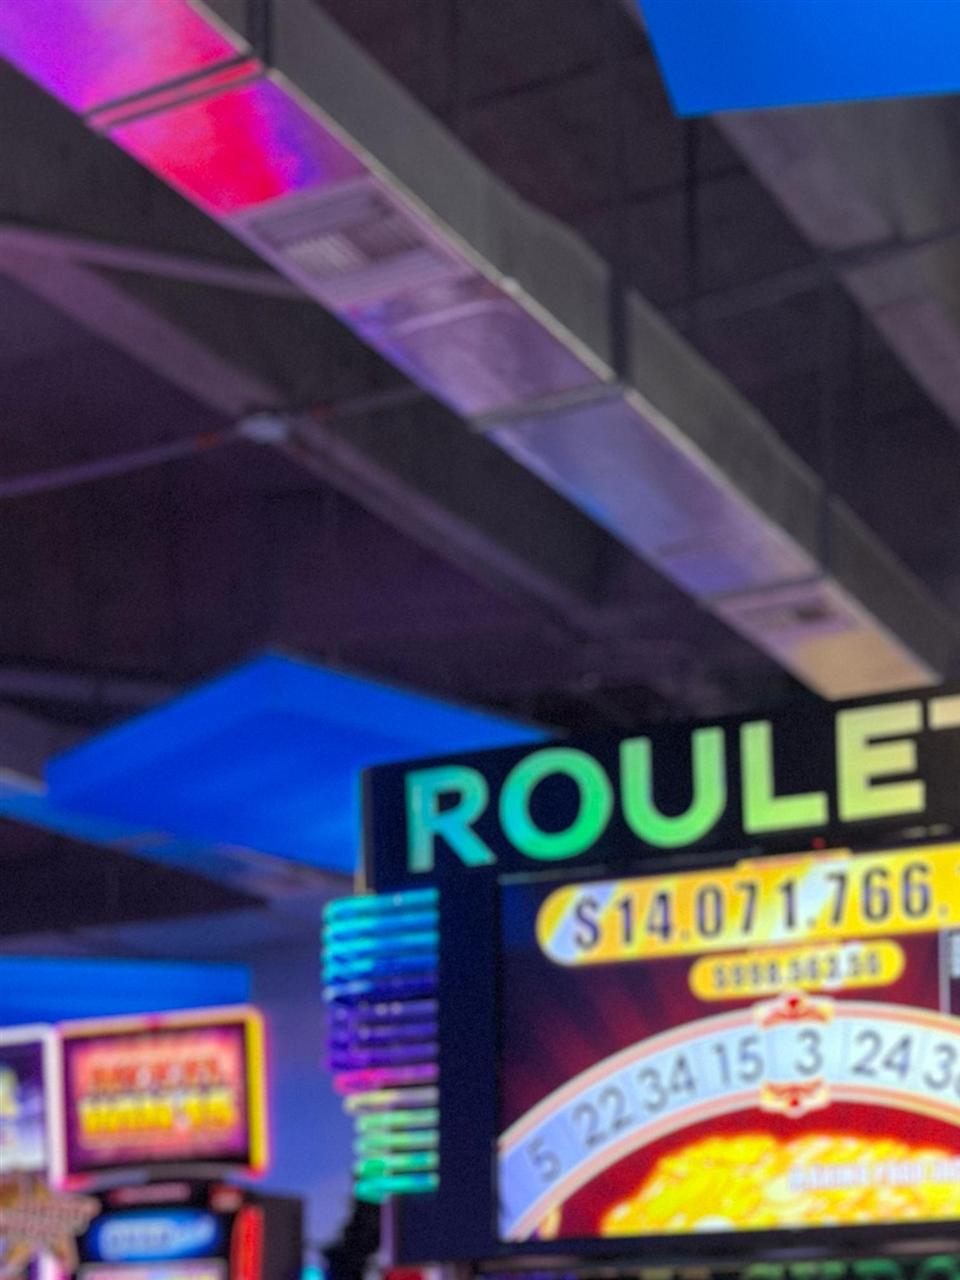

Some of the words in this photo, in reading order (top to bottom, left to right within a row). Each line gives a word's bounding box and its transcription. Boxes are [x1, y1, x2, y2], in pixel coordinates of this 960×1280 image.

[526, 1137, 562, 1183] 5
[571, 1086, 632, 1148] 22
[637, 1054, 697, 1112] 34
[711, 1035, 765, 1084] 15
[794, 1028, 824, 1076] 3
[852, 1029, 914, 1079] 24
